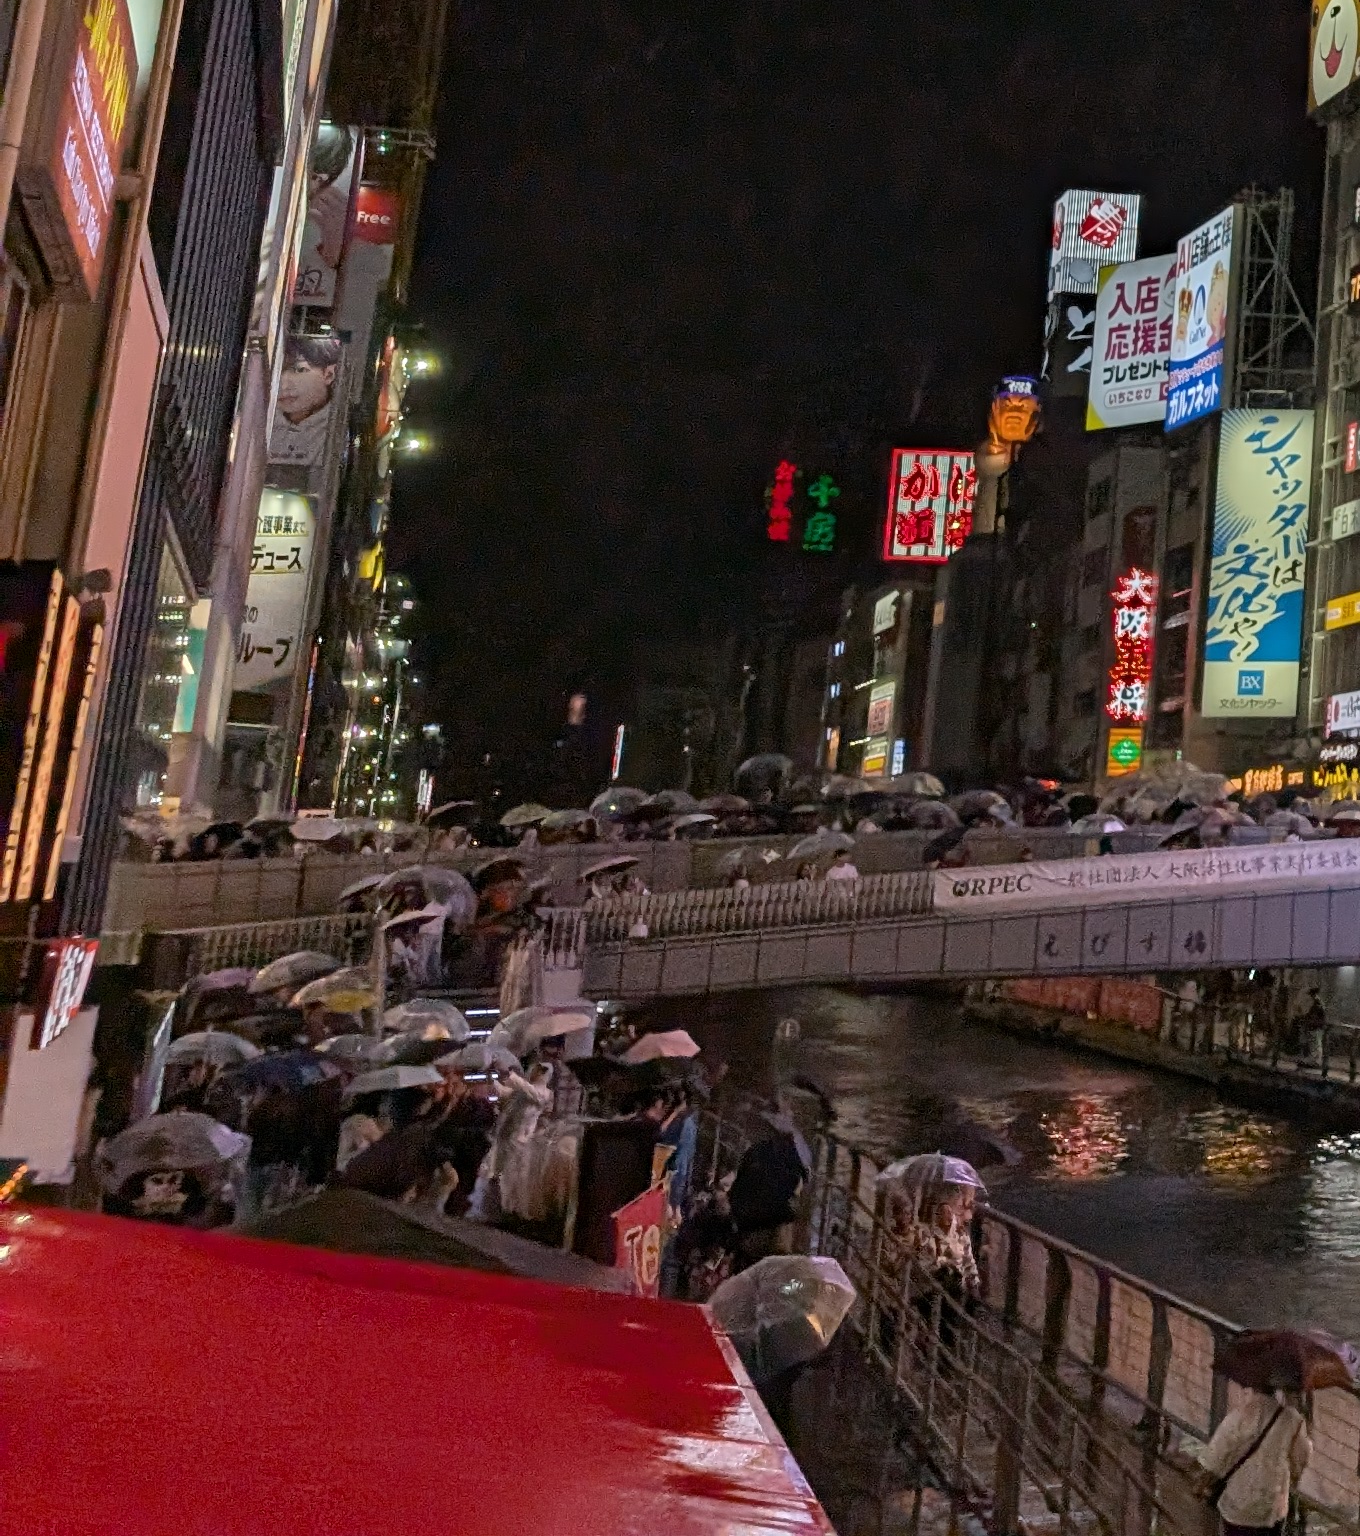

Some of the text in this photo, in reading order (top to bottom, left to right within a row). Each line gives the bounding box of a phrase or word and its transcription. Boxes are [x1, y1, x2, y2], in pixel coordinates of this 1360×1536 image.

[356, 210, 392, 226] Free
[1107, 276, 1161, 319] 入店
[1168, 374, 1219, 426] ガルフネット
[1241, 675, 1262, 691] BX
[1219, 698, 1283, 710] 文化シャッター
